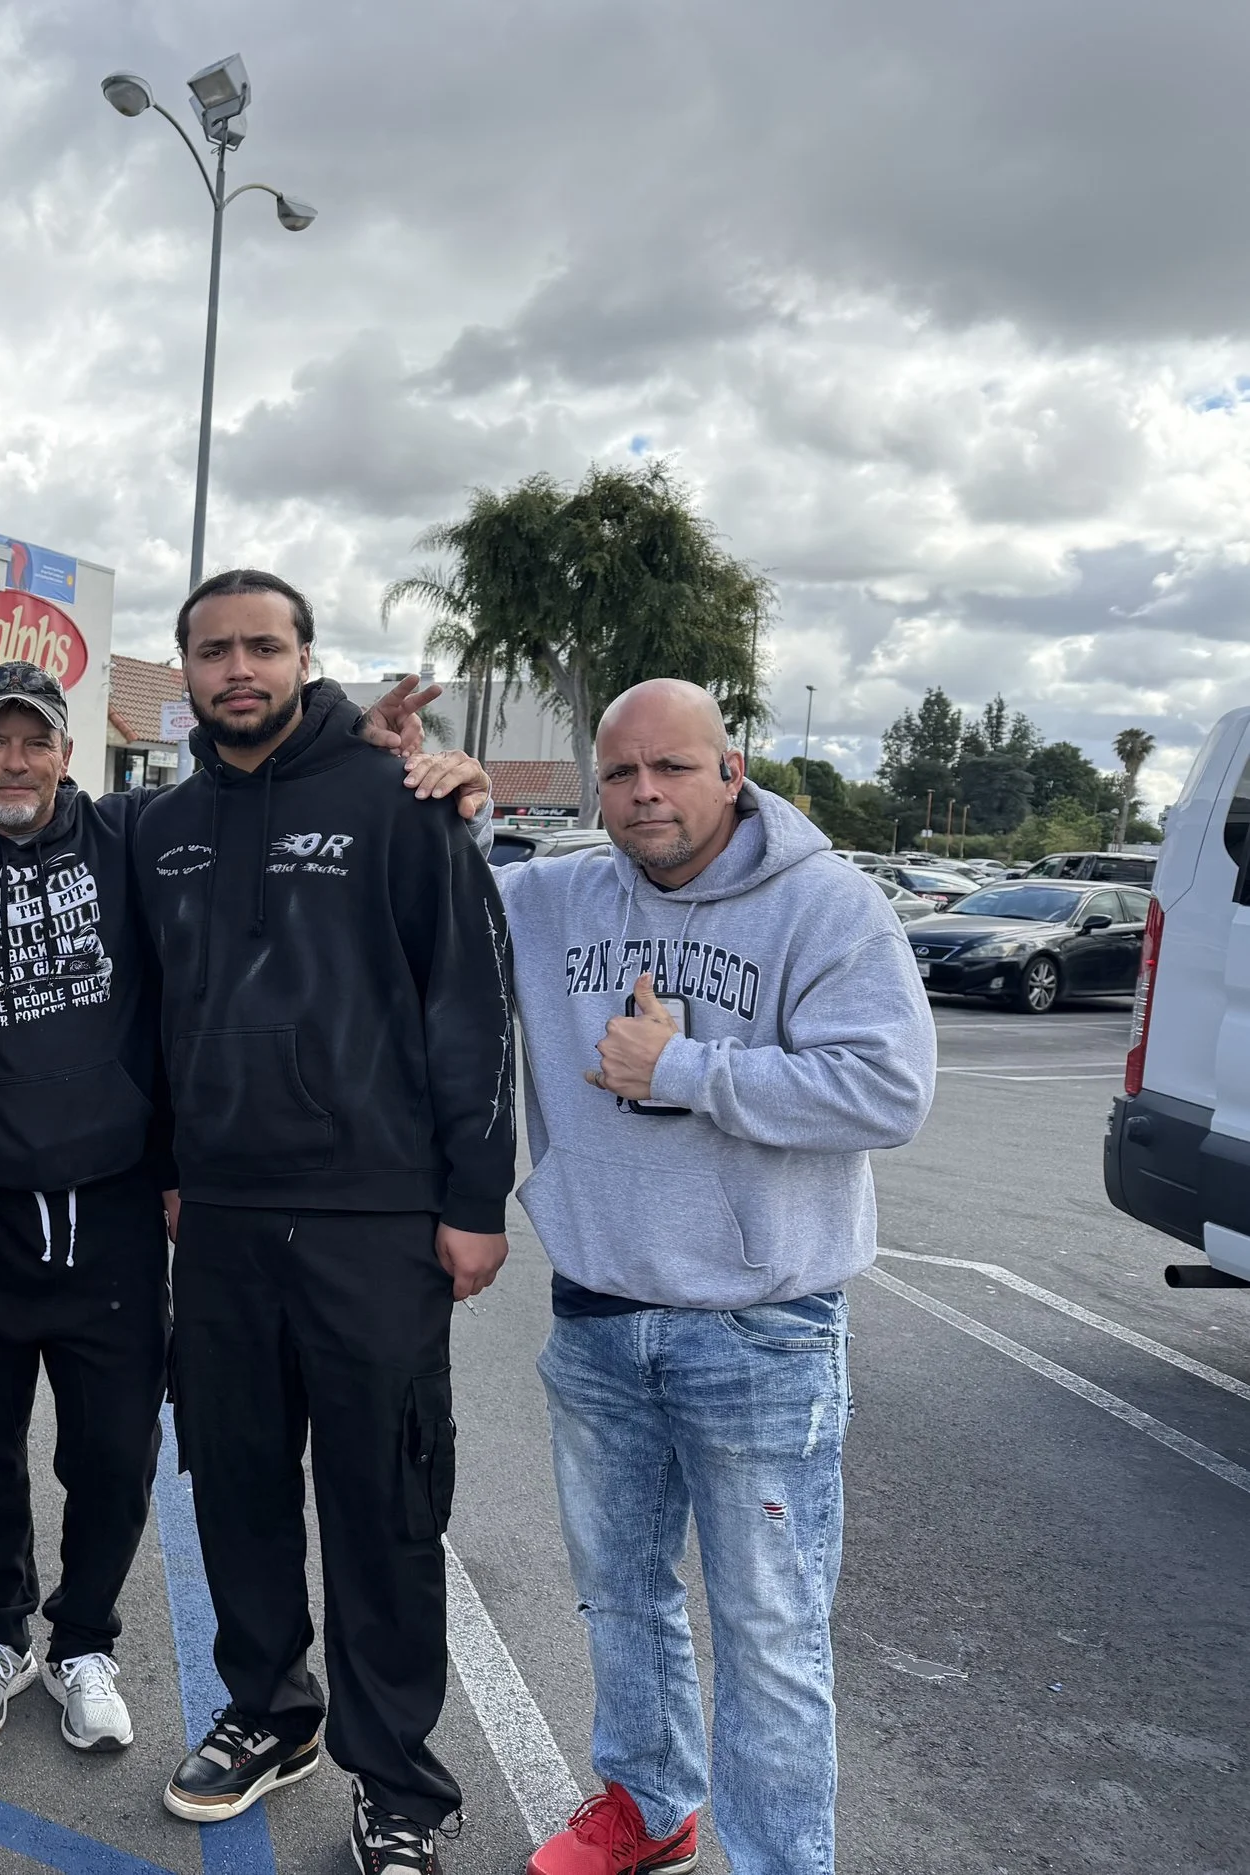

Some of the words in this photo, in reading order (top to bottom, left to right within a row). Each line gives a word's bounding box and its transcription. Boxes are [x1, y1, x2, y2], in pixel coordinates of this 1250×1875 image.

[9, 942, 48, 963] BACK
[56, 934, 73, 955] IN
[14, 987, 66, 1010] PEOPLE
[71, 977, 99, 996] OUT.
[565, 938, 613, 997] SAN
[614, 938, 761, 1023] FRANCISCO
